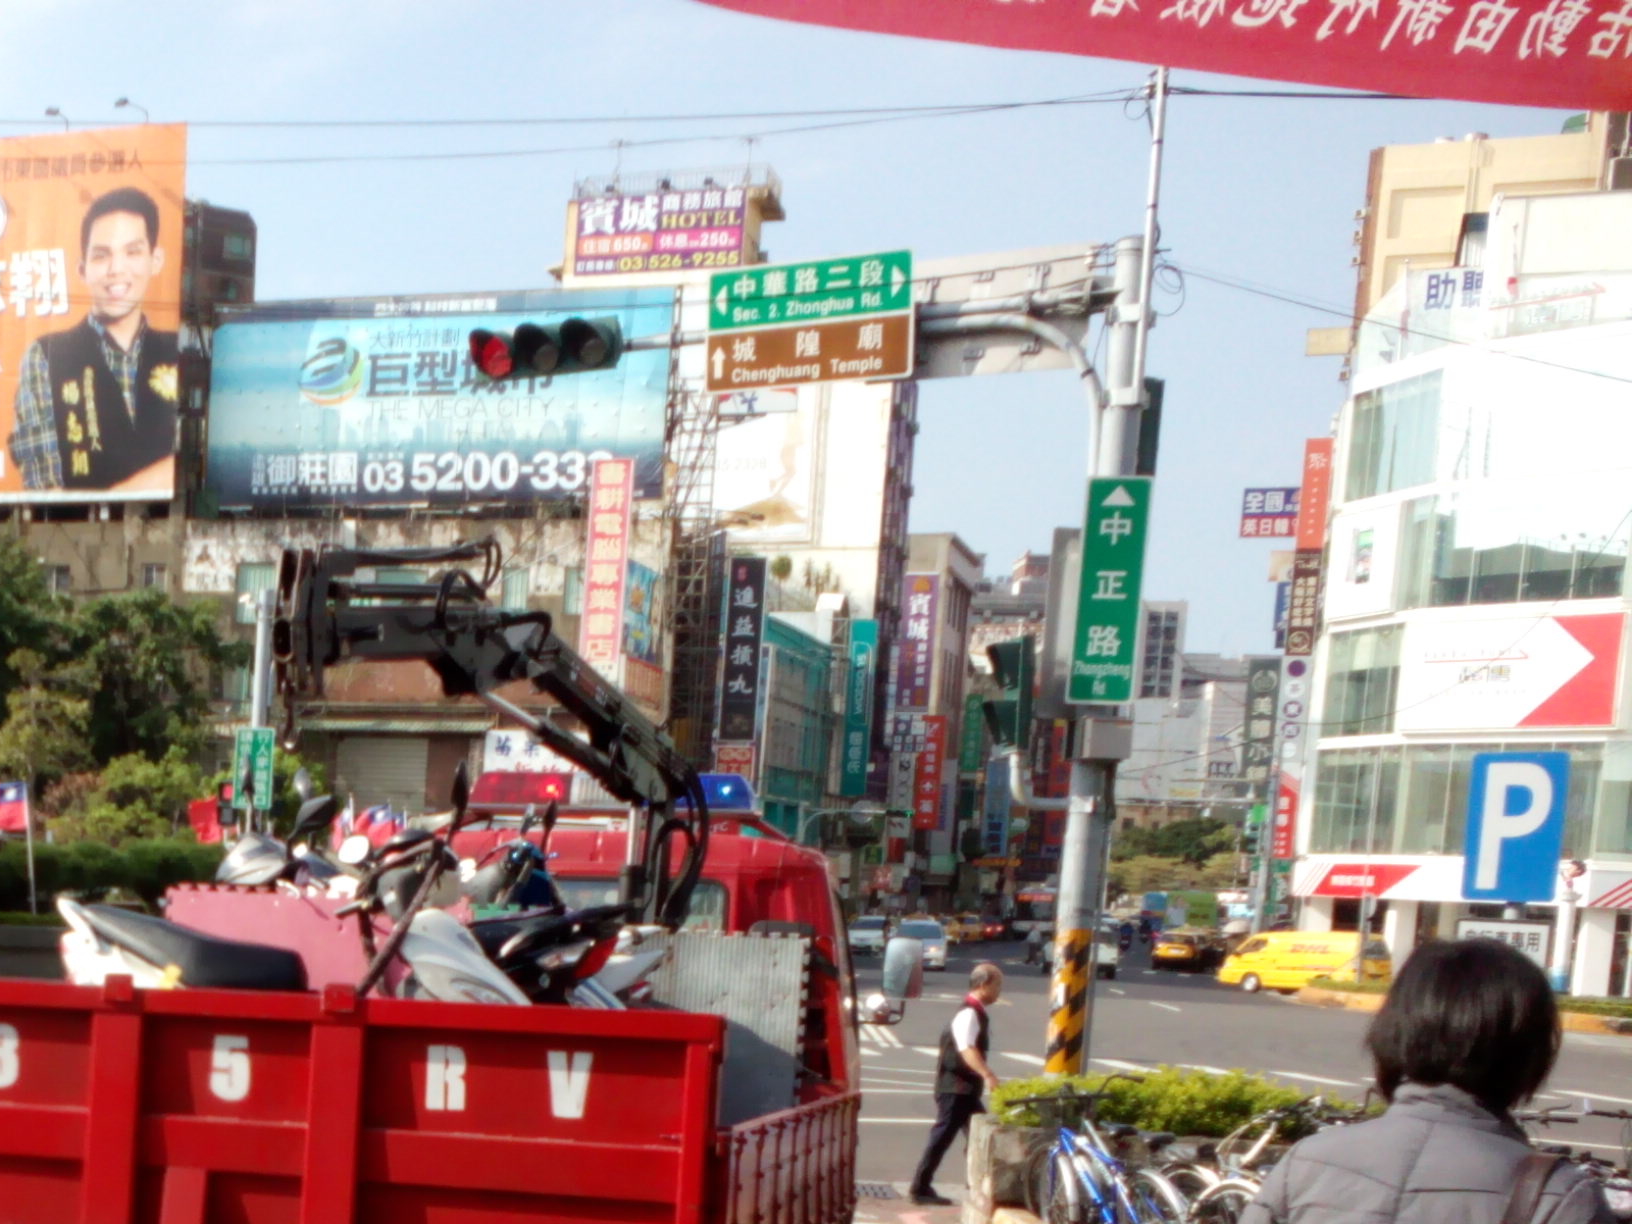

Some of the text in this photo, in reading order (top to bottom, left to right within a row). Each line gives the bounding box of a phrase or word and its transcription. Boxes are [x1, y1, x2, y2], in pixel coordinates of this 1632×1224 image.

[662, 211, 742, 229] HOTEL
[733, 260, 885, 302] 中華路二段
[732, 305, 760, 323] Sec.
[786, 297, 855, 318] Zhonghua
[861, 291, 883, 308] Rd.
[732, 322, 884, 362] 城隍廟
[731, 356, 884, 382] Chenghuang Temple
[369, 396, 557, 422] THE MEGA CITY
[364, 460, 405, 494] 03
[1086, 511, 1133, 658] 中正路
[1474, 761, 1554, 890] P
[209, 1035, 253, 1101] 5
[424, 1044, 468, 1112] R
[546, 1050, 594, 1120] V
